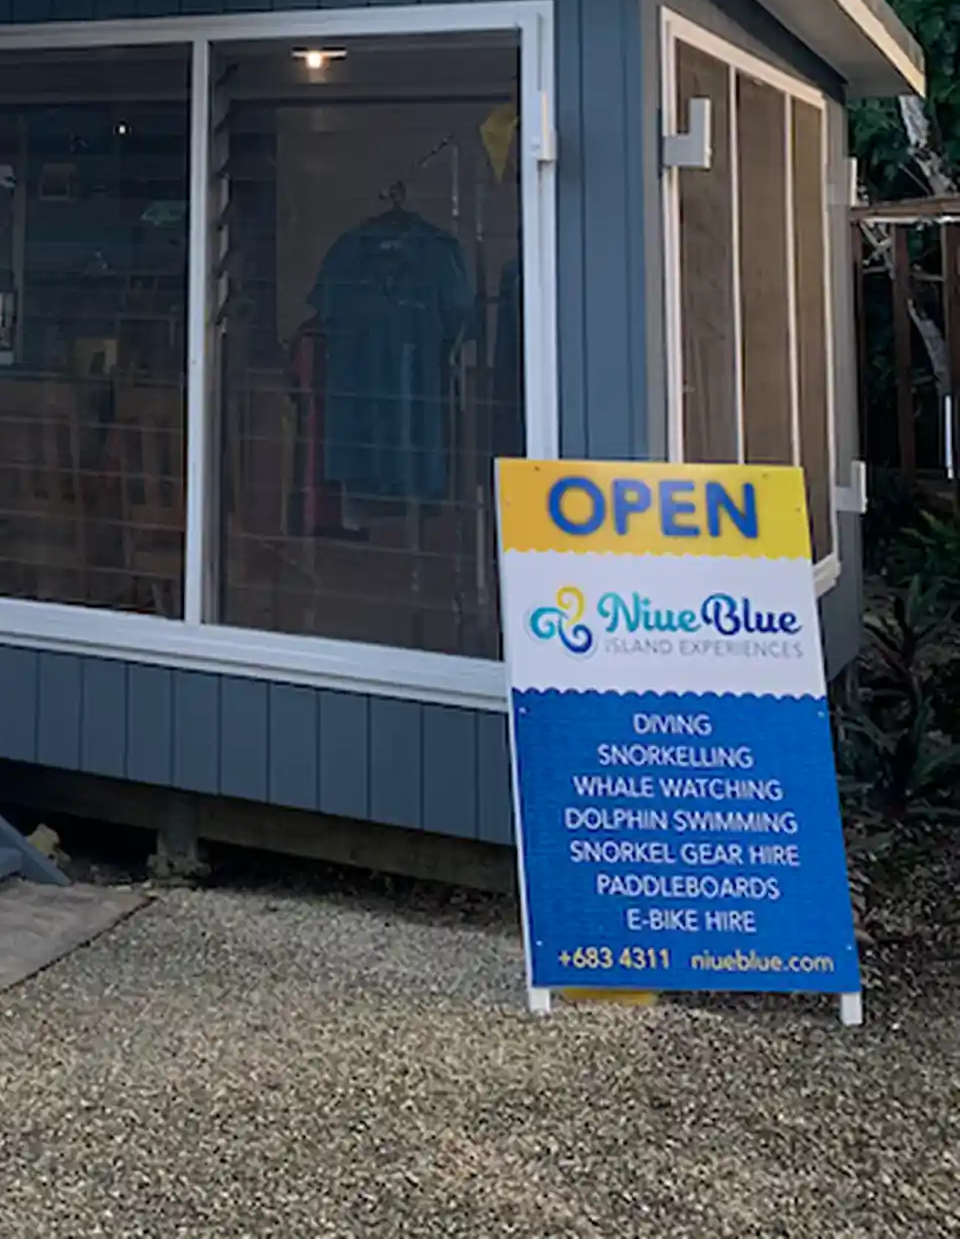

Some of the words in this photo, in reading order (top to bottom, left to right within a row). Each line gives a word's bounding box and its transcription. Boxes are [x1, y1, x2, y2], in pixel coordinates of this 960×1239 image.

[548, 476, 759, 539] OPEN
[604, 638, 672, 654] ISLAND
[678, 640, 803, 659] EXPERIENCES
[633, 714, 712, 735] DIVING
[598, 744, 754, 769] SNORKELLING
[573, 776, 654, 798] WHALE
[659, 778, 783, 801] WATCHING
[564, 808, 668, 831] DOLPHIN
[674, 811, 798, 834] SWIMMING
[570, 840, 675, 864] SNORKEL
[681, 843, 742, 865] GEAR
[749, 845, 801, 866] HIRE
[597, 874, 781, 900] PADDLEBOARDS
[627, 909, 698, 931] E-BIKE
[705, 911, 757, 933] HIRE
[558, 947, 612, 969] +683
[618, 948, 669, 969] 4311
[691, 950, 834, 973] niueblue.com
